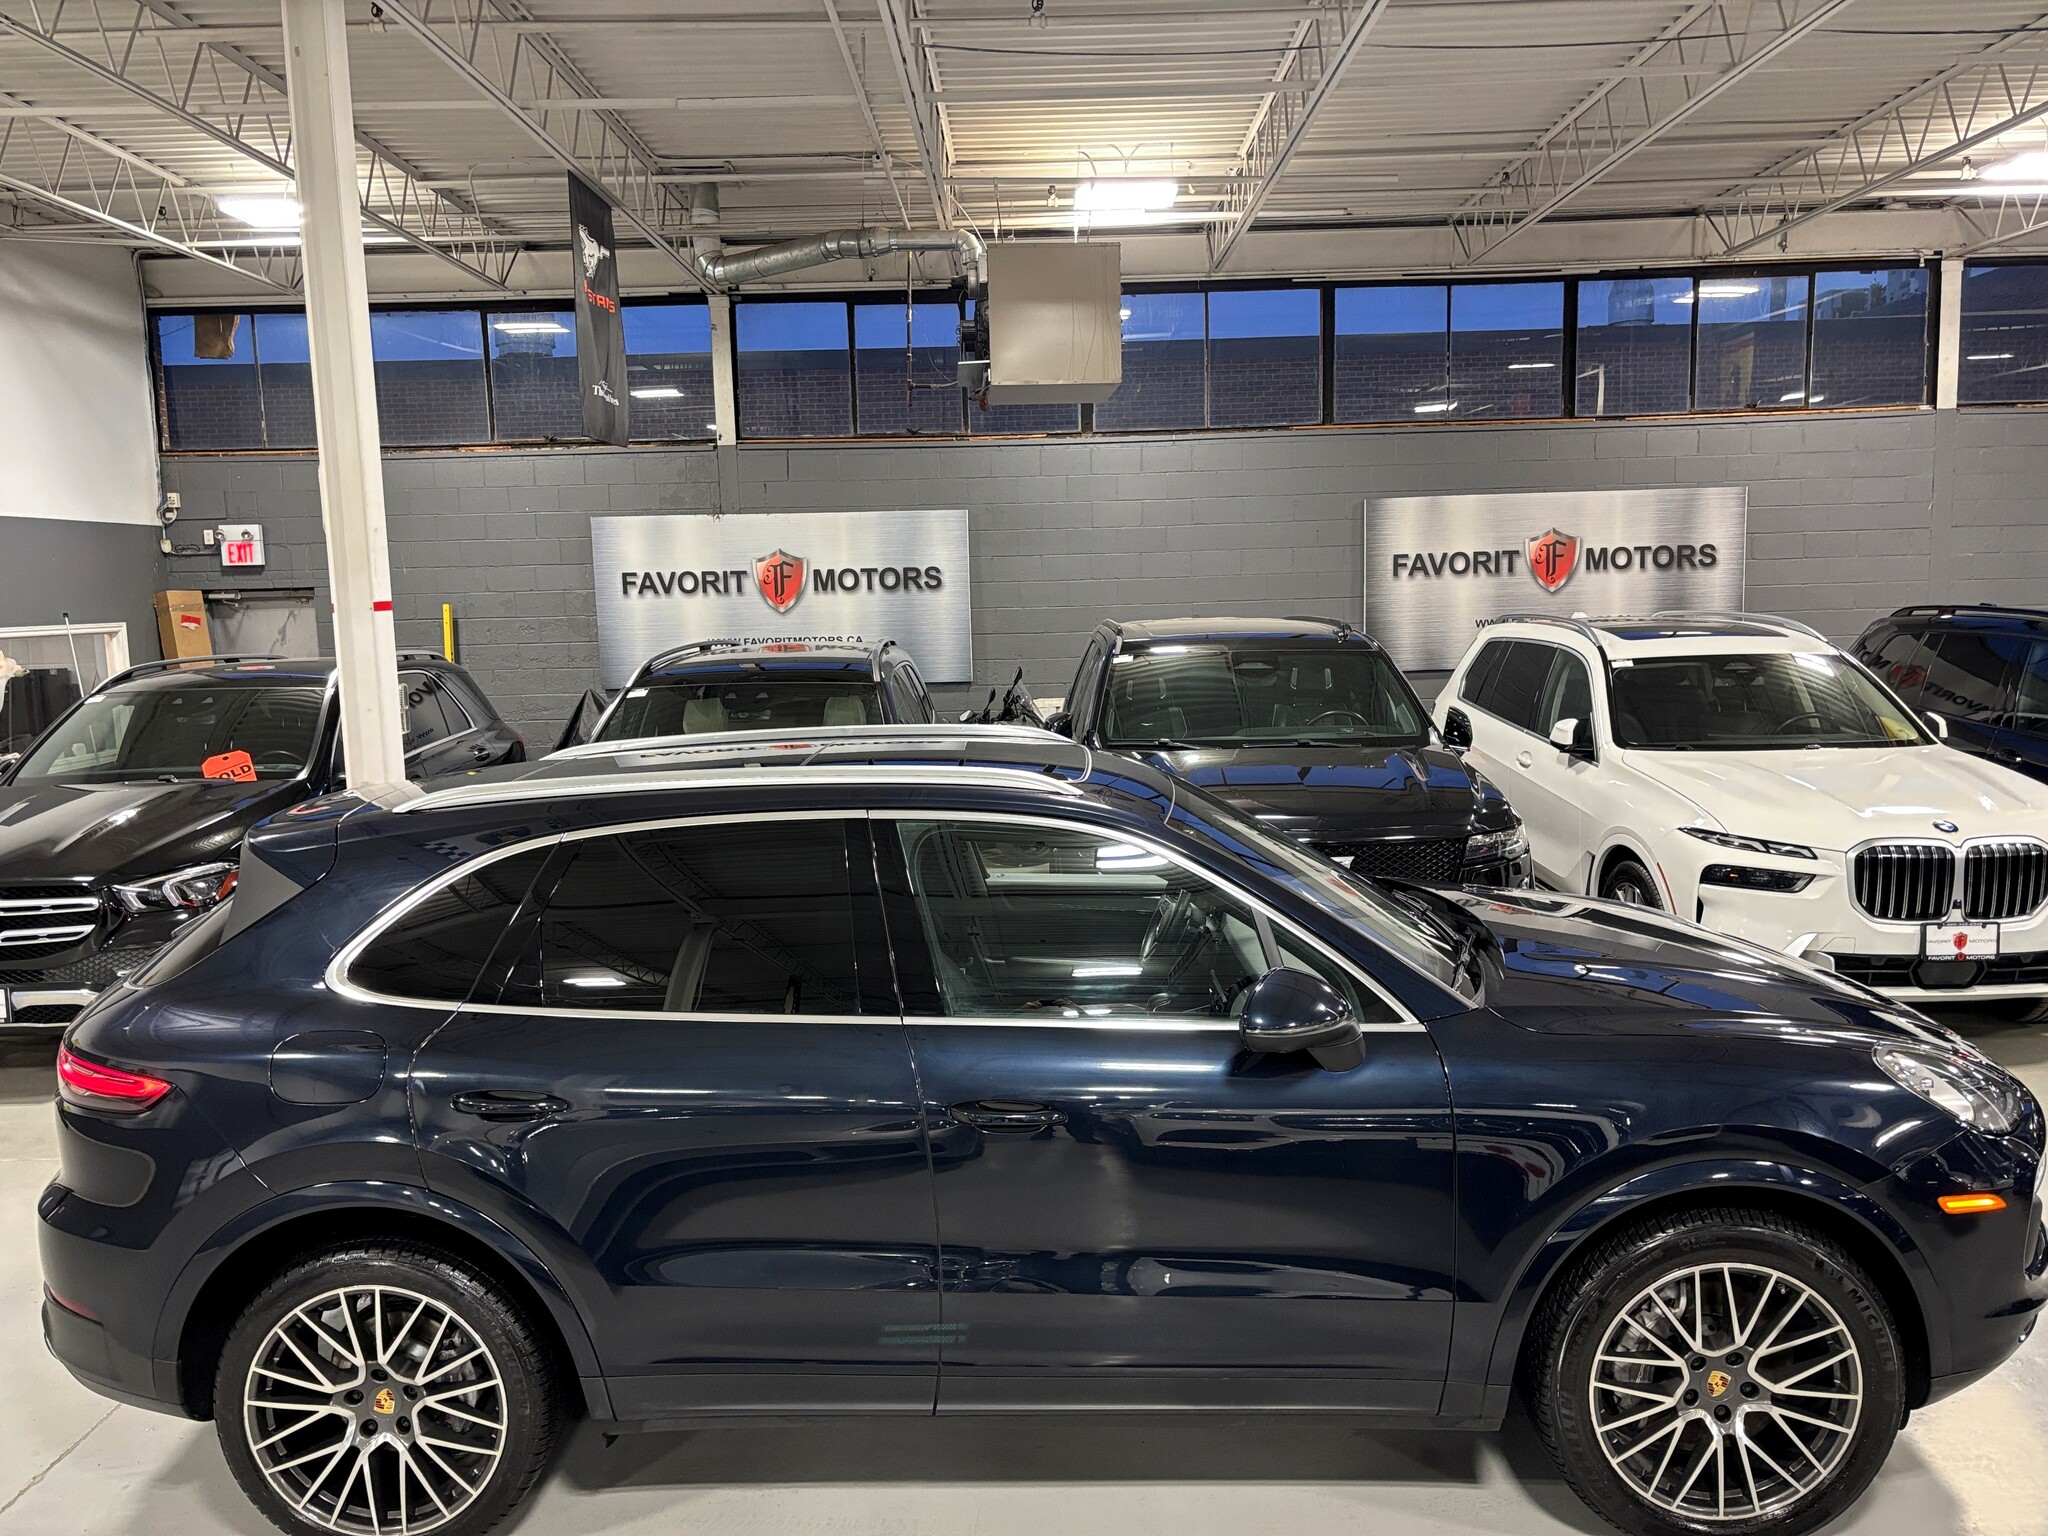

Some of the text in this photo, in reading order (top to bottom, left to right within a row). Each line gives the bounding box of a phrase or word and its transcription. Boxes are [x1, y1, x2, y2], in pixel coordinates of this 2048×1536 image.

[227, 543, 254, 564] EXIT
[1392, 549, 1520, 577] FAVORIT
[1585, 543, 1718, 571] MOTORS
[621, 570, 748, 595] FAVORIT
[813, 566, 943, 592] MOTORS
[707, 635, 863, 646] FAVORITMOTORSCA
[213, 764, 252, 779] OLD
